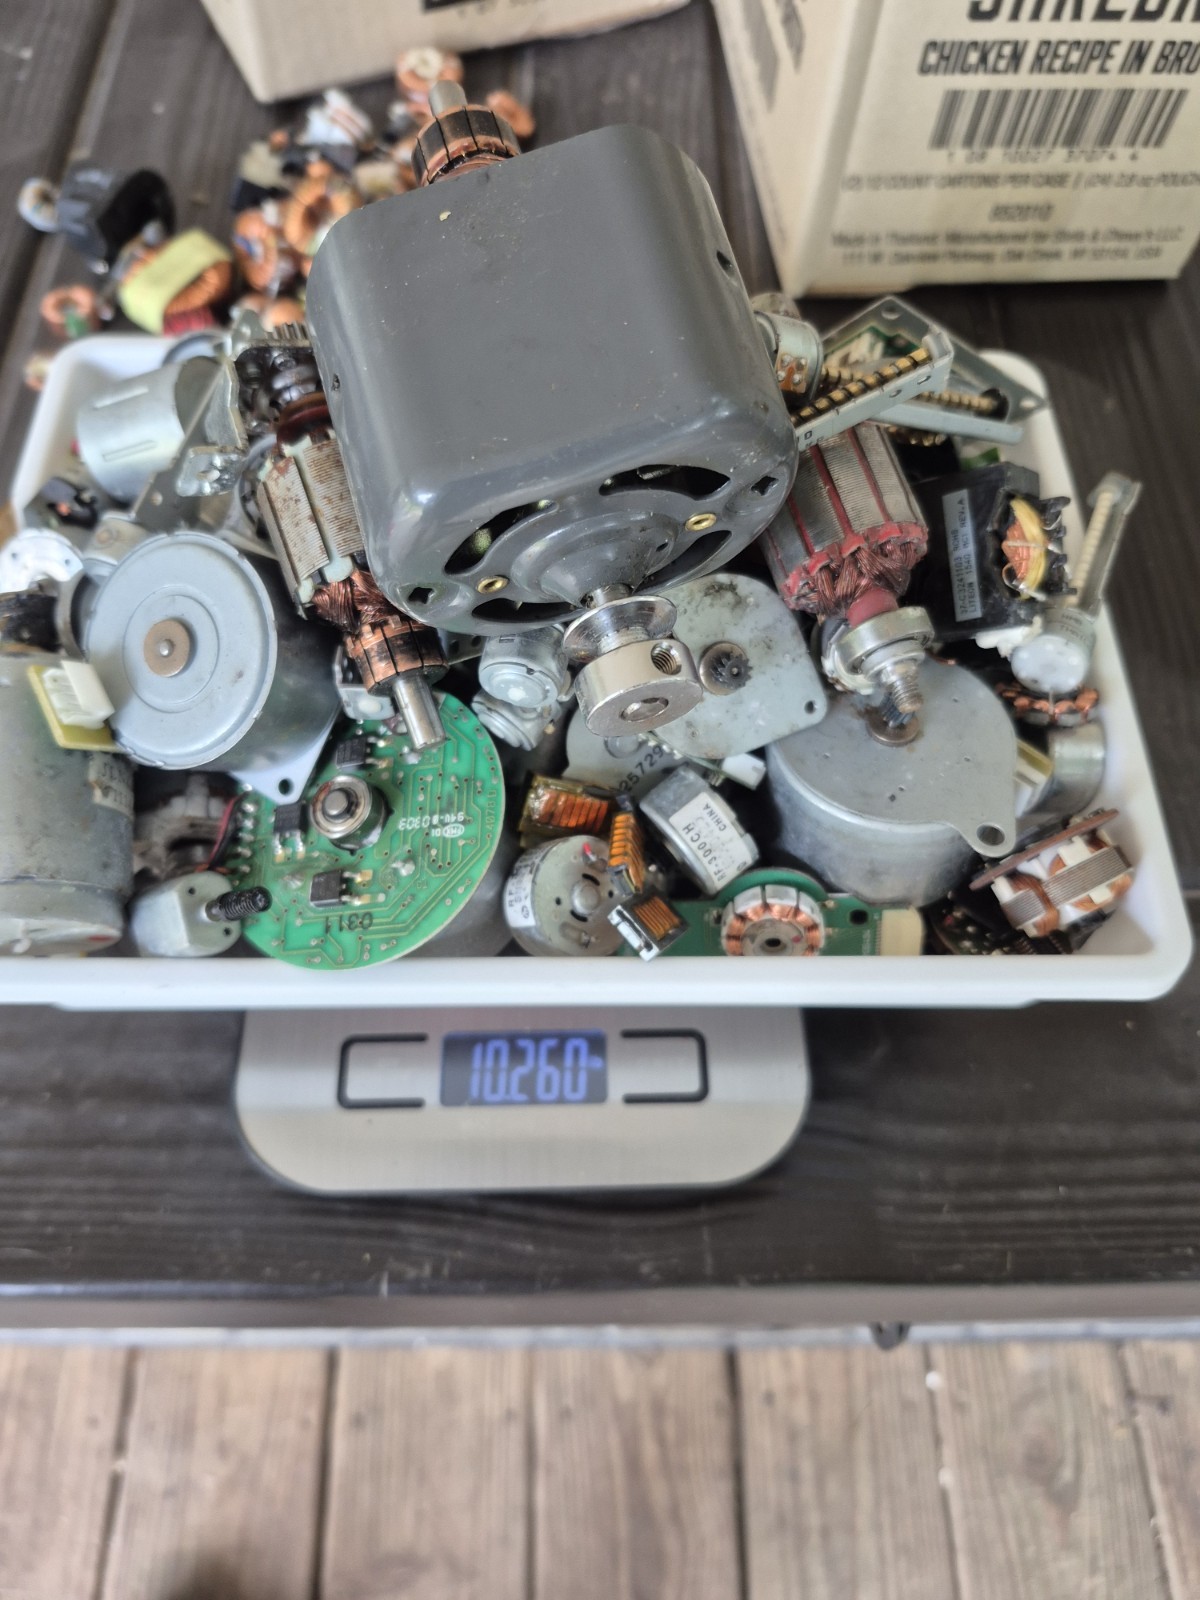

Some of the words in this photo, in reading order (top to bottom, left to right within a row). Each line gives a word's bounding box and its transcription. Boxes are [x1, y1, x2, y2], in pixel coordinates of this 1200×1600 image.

[917, 40, 1028, 76] CHICKEN
[1029, 40, 1121, 75] RECIPE
[1118, 40, 1154, 75] IN
[702, 802, 728, 833] CHINA
[681, 822, 727, 882] RF-300CH
[324, 911, 373, 935] 0311
